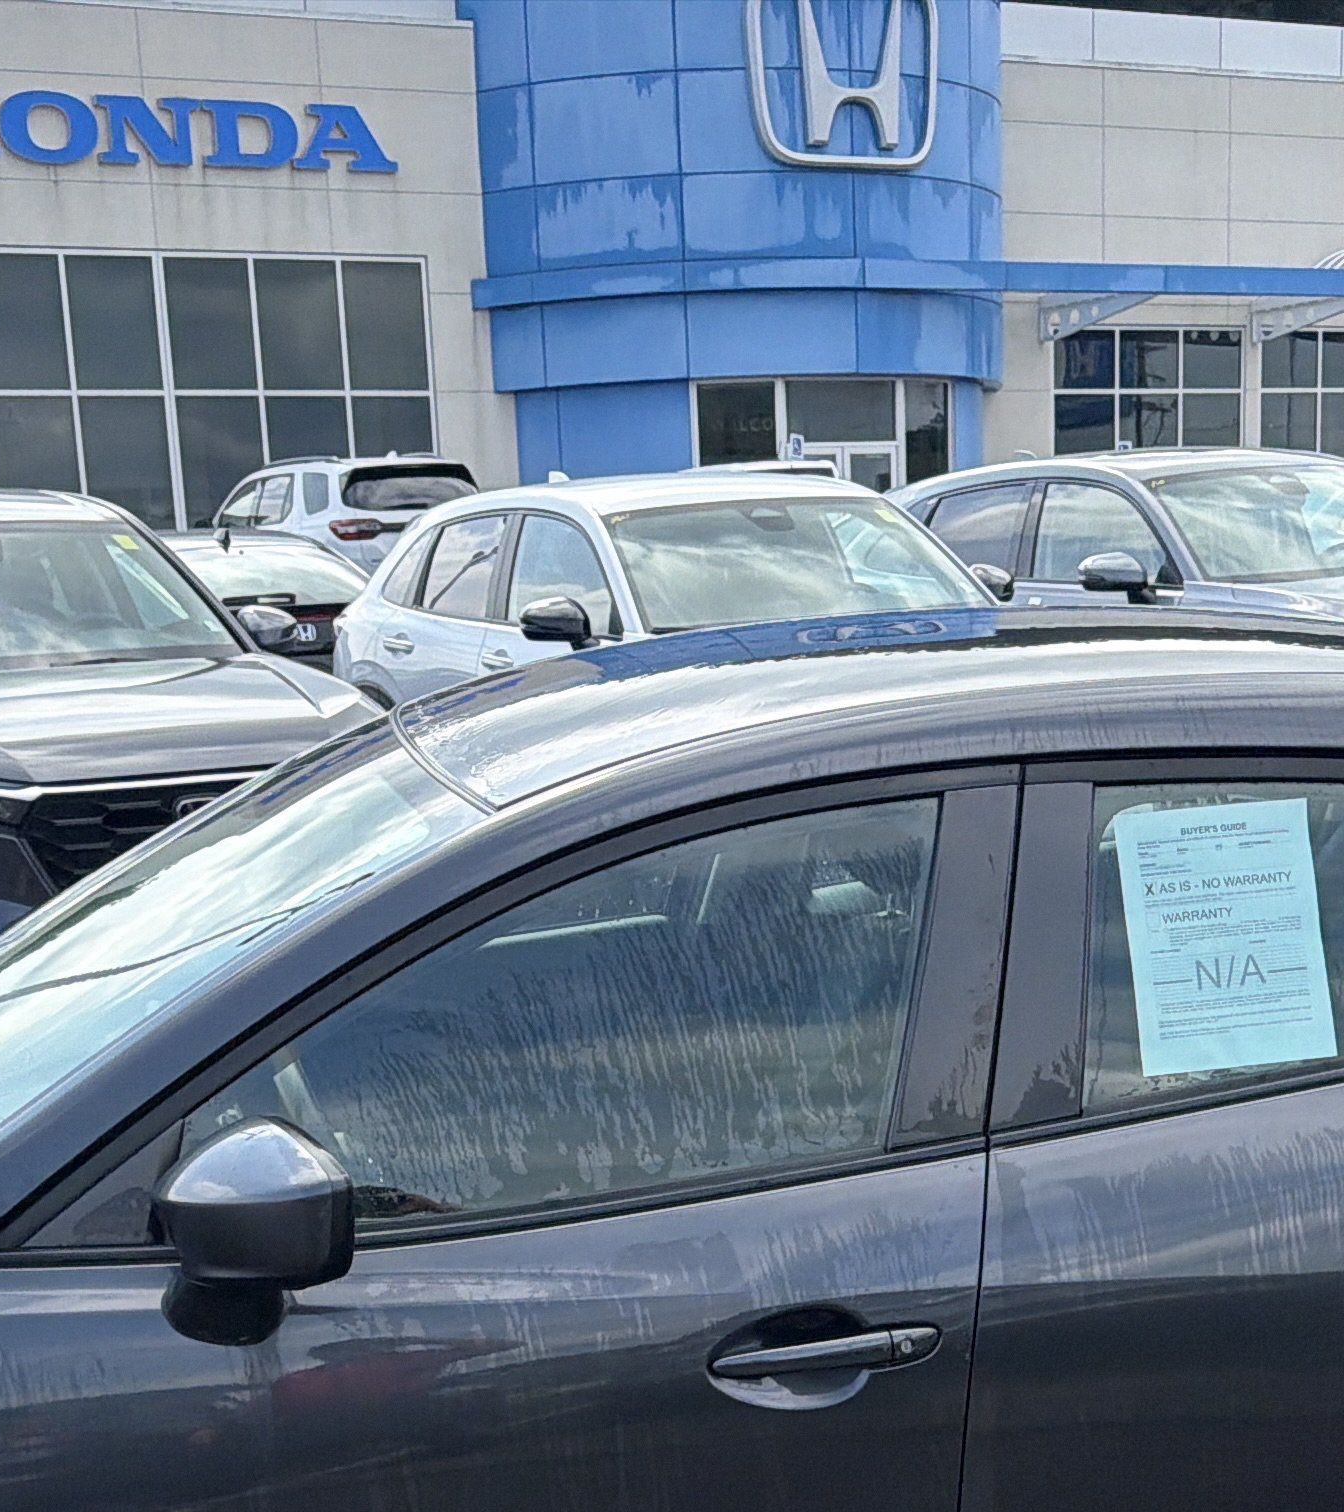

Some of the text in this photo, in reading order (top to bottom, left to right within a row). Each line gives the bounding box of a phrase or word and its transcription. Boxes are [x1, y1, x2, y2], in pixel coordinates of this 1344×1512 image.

[1180, 821, 1248, 836] BUYER'S GUIDE
[1159, 882, 1176, 895] AS
[1179, 879, 1191, 892] IS
[1202, 877, 1221, 890] NO
[1223, 870, 1292, 888] WARRANTY
[1162, 906, 1233, 925] WARRANTY
[1194, 953, 1268, 991] N/A
